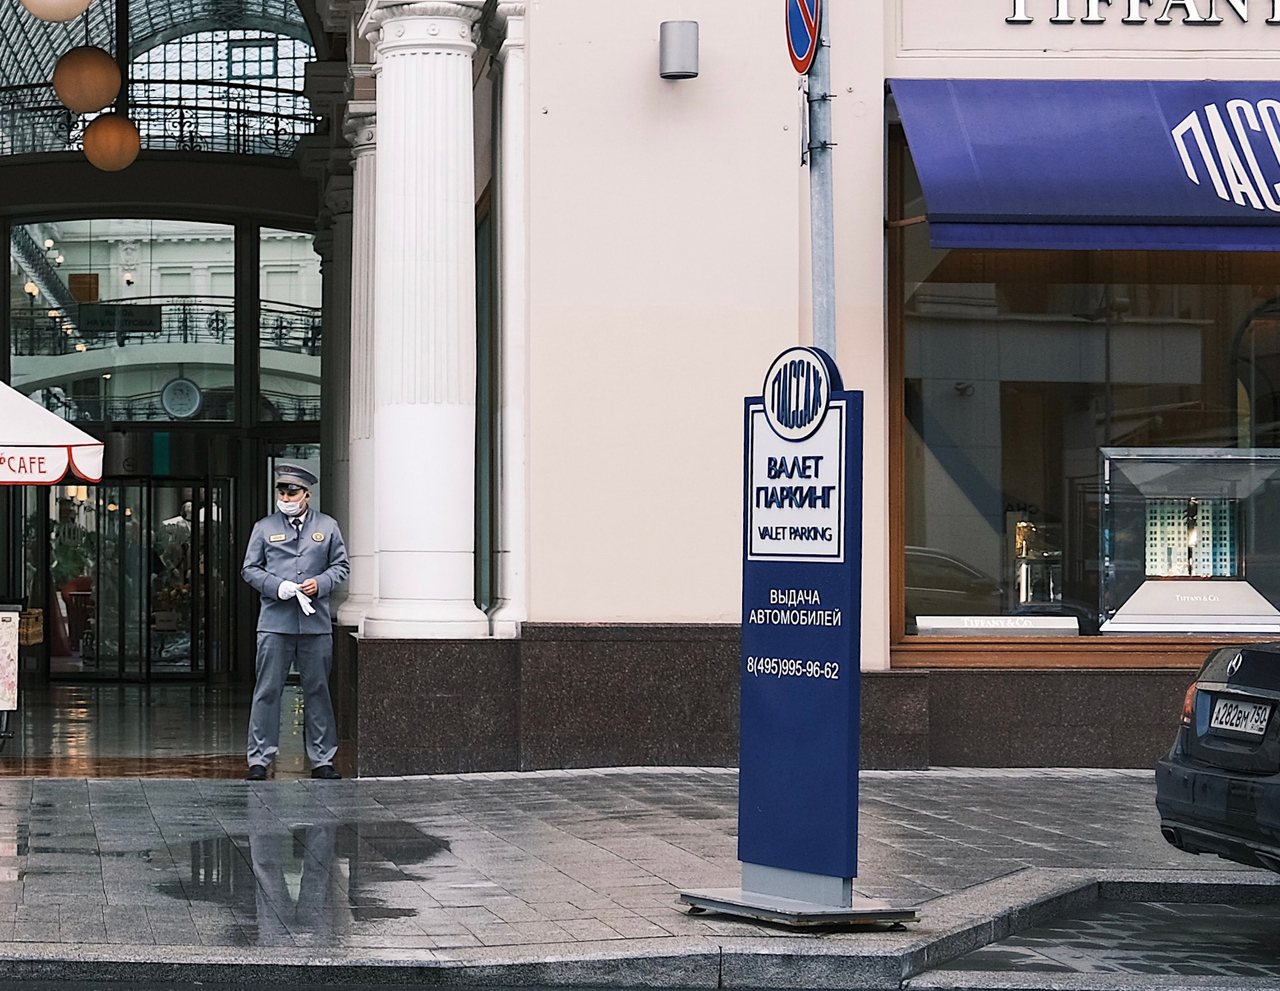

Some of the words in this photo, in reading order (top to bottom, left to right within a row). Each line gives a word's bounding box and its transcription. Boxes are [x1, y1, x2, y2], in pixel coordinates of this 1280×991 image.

[771, 359, 822, 429] ПАССАЖ
[8, 456, 47, 474] CAFE
[767, 456, 823, 479] ВАЛЕТ
[756, 486, 836, 509] ПАРКИНГ
[758, 526, 787, 540] VALET
[789, 526, 833, 541] PARKING
[770, 589, 821, 607] ВЫДАЧА
[749, 608, 842, 626] АВТОМОБИЛЕЙ
[961, 617, 1005, 627] TIFFANY
[747, 656, 839, 679] 8(495)995-96-62
[1214, 703, 1250, 728] А282ВМ
[1250, 705, 1267, 724] 750
